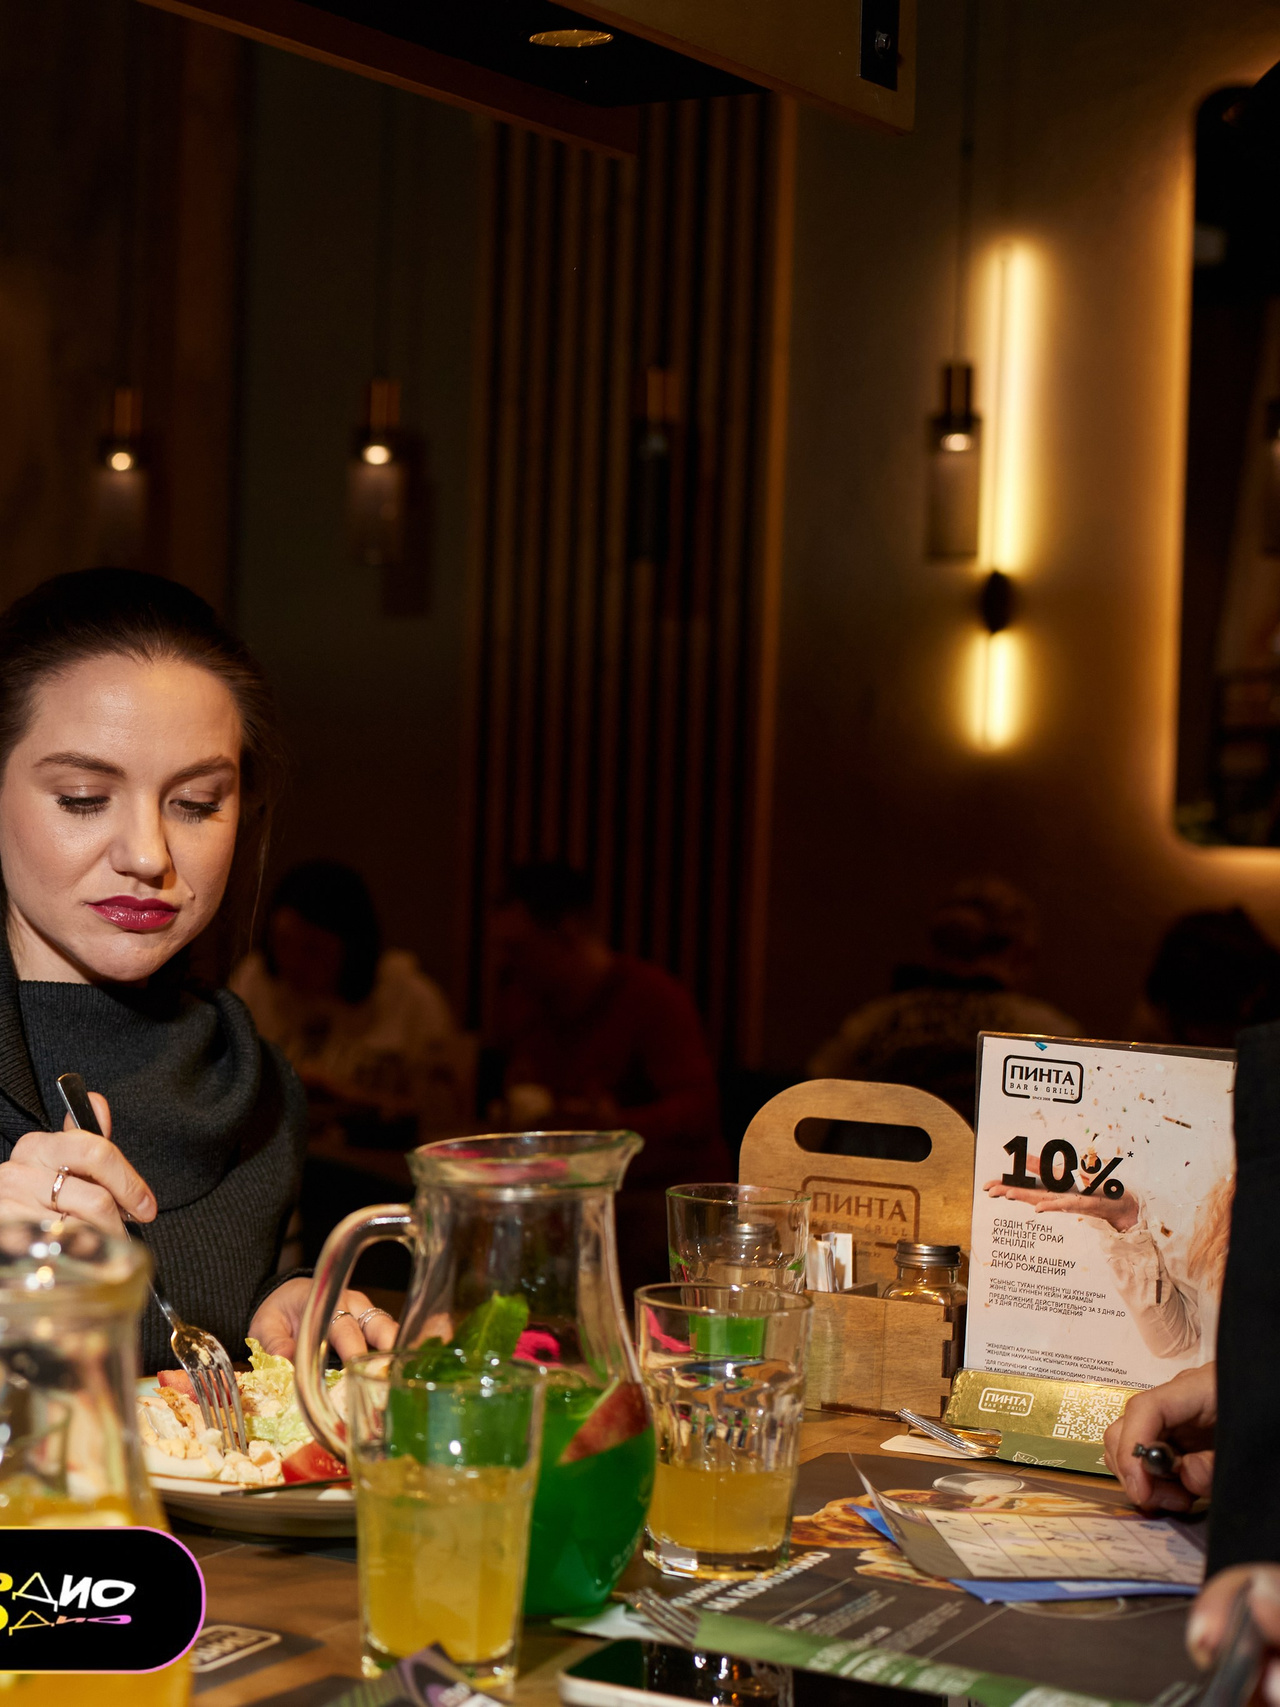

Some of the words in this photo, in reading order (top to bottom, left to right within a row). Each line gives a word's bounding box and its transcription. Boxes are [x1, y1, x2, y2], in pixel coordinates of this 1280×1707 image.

[1010, 1065, 1075, 1086] ПИНТА
[1009, 1082, 1028, 1091] BAR
[1045, 1086, 1075, 1095] GRILL
[812, 1191, 907, 1222] ПИНТА
[864, 1223, 908, 1236] GRILL
[993, 1218, 1023, 1230] СІЗДІҢ
[1026, 1220, 1053, 1233] ТУҒАН
[992, 1227, 1037, 1240] КҮНІҢІЗГЕ
[1039, 1233, 1064, 1243] ОРАЙ
[992, 1236, 1035, 1249] ЖЕҢІЛДІК
[991, 1250, 1027, 1262] СКИДКА
[1029, 1255, 1035, 1263] К
[1037, 1256, 1076, 1269] ВАШЕМУ
[990, 1259, 1013, 1269] ДНЮ
[1015, 1262, 1067, 1276] РОЖДЕНИЯ
[989, 1292, 1033, 1304] ПРЕДЛОЖЕНИЕ
[1035, 1299, 1087, 1311] ДЕЙСТВИТЕЛЬНО
[1062, 1294, 1093, 1303] ЖАРАМДЫ
[1013, 1301, 1034, 1310] ПОСЛЕ
[1048, 1306, 1083, 1316] РОЖДЕНИЯ
[997, 1360, 1027, 1369] ПОЛУЧЕНИЯ
[1049, 1367, 1086, 1379] НЕОБХОДИМО
[1087, 1375, 1119, 1385] ПРЕДЪЯВИТЬ
[985, 1392, 1027, 1407] ПИНТА
